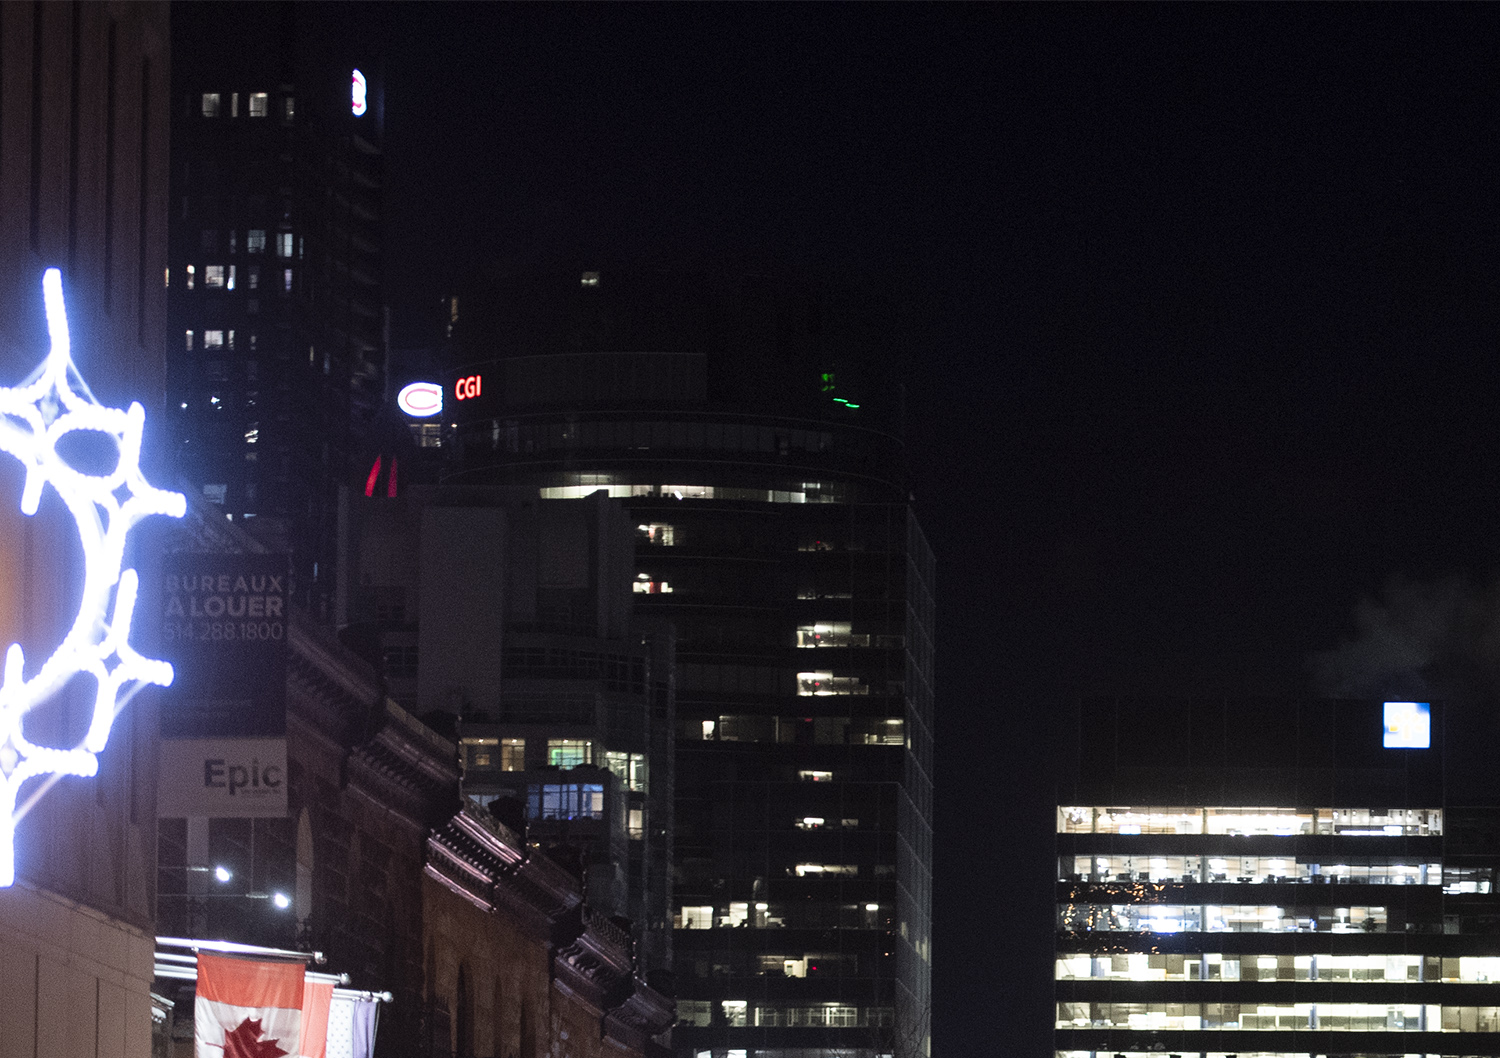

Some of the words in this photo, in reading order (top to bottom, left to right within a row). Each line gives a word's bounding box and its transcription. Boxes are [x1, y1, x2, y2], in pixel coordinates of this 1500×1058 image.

[455, 375, 482, 401] CGI
[166, 575, 283, 593] BUREAUX
[189, 595, 283, 618] LOUER
[204, 758, 282, 795] Epic
